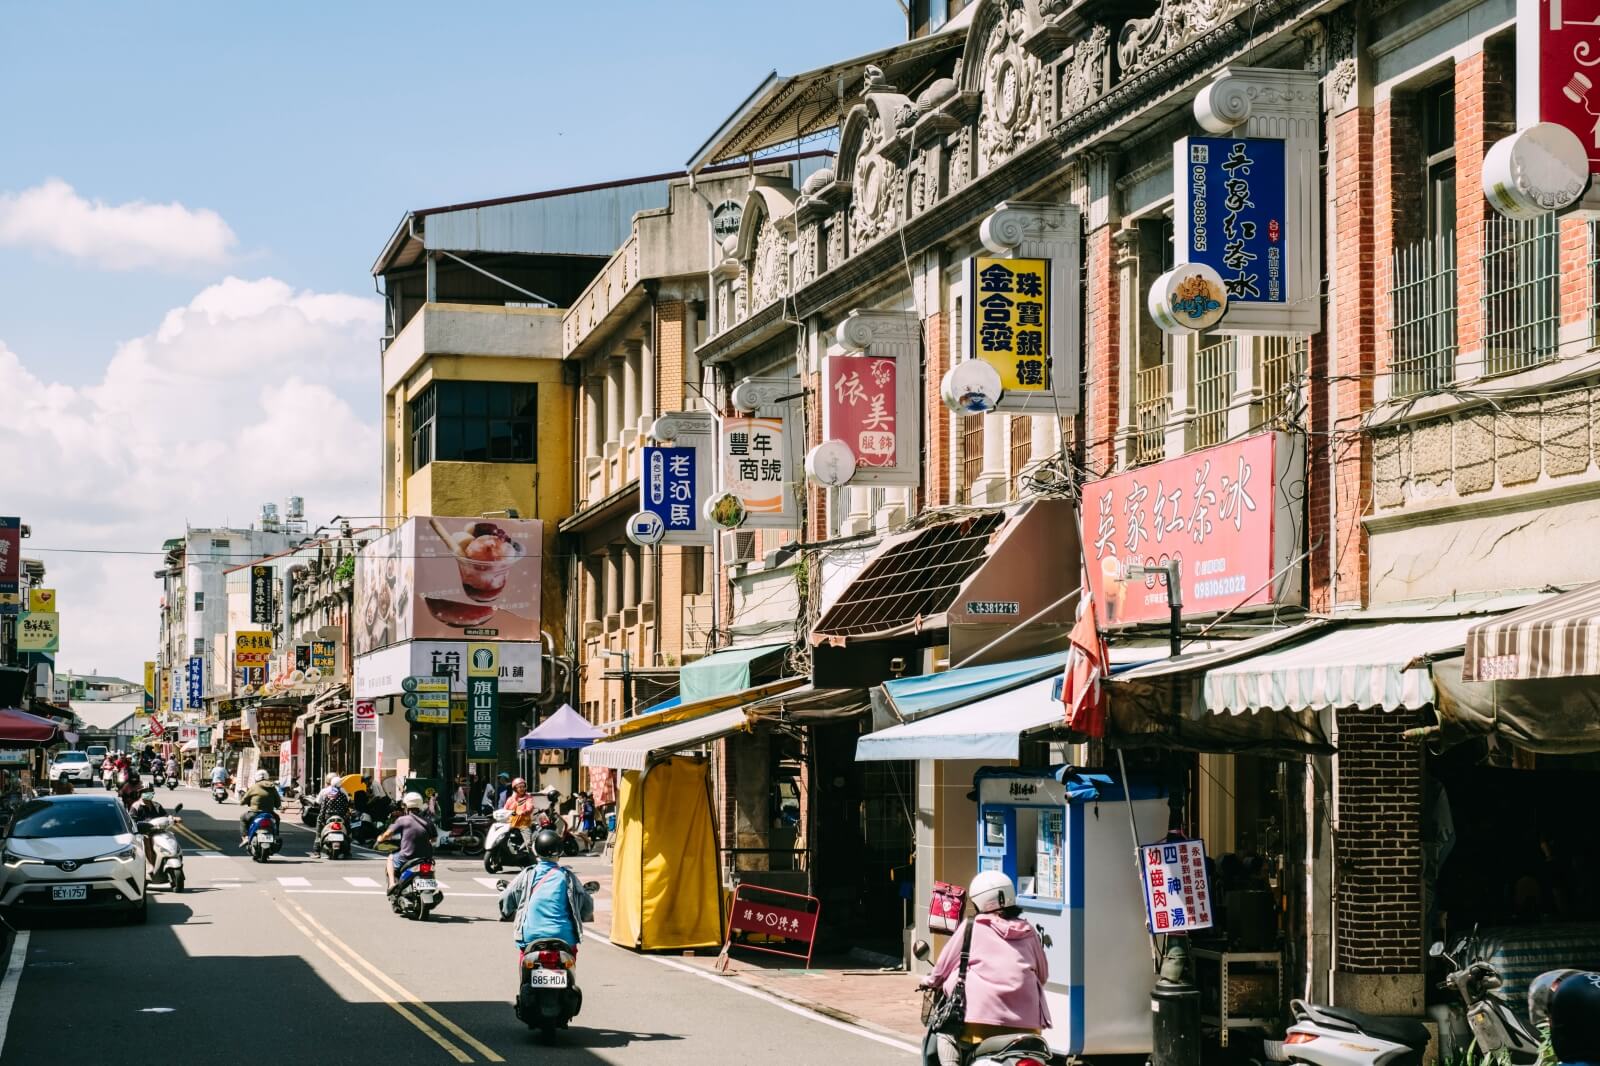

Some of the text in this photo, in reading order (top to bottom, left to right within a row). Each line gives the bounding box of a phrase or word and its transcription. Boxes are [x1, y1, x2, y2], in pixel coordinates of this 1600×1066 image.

[1193, 165, 1207, 251] 0917-988-065
[1221, 142, 1260, 299] 吳家紅茶冰
[980, 263, 1014, 352] 金合發
[1015, 271, 1043, 385] 珠寶銀樓
[834, 371, 895, 431] 依美
[729, 432, 773, 456] 豐年
[738, 458, 782, 482] 商號
[862, 433, 894, 452] 服飾
[669, 454, 692, 527] 老河馬
[1094, 455, 1257, 560] 吳家紅茶冰
[356, 703, 375, 716] OK
[473, 680, 493, 752] 旗山區農會
[1147, 846, 1170, 929] 幼齒肉圓
[1163, 845, 1186, 927] 四神湯
